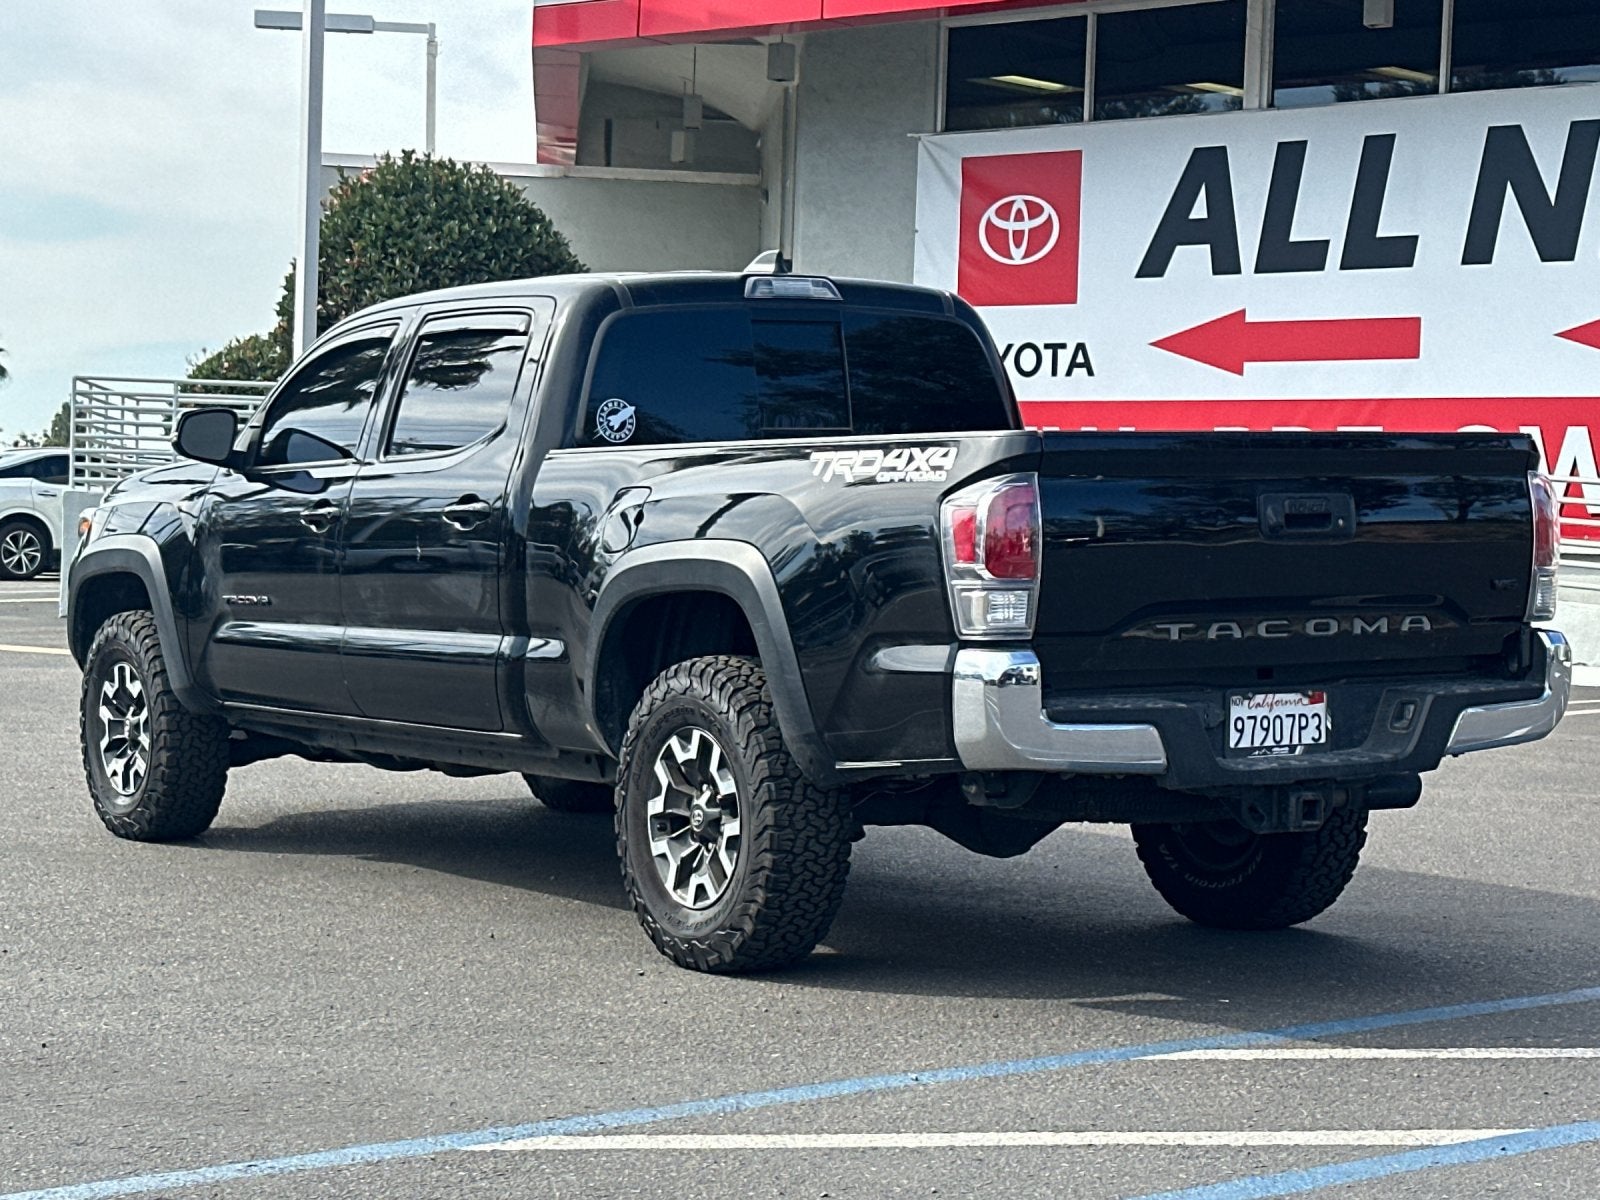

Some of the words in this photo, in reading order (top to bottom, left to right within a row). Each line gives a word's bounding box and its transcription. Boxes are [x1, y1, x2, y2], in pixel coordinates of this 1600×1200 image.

[1134, 133, 1420, 278] ALL
[1155, 615, 1432, 641] TACOMA
[1248, 692, 1305, 713] California
[1233, 712, 1322, 748] 97907P3
